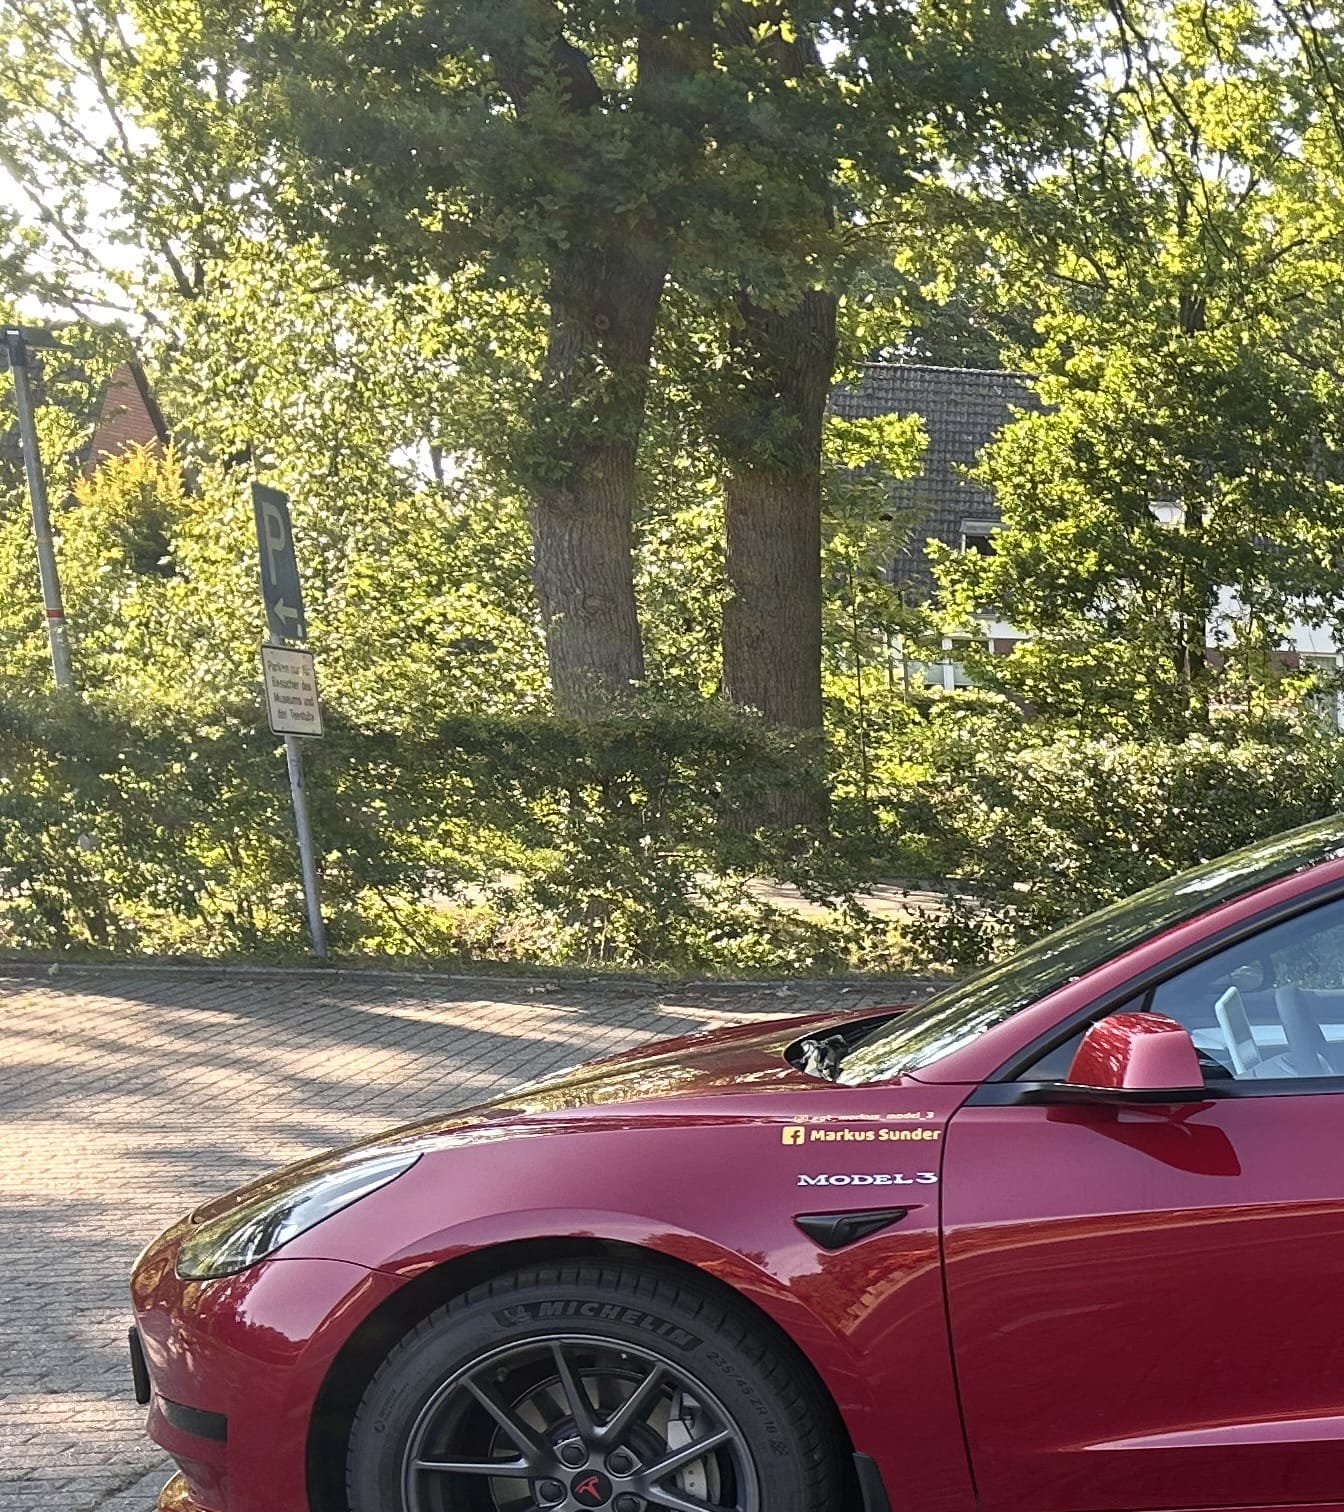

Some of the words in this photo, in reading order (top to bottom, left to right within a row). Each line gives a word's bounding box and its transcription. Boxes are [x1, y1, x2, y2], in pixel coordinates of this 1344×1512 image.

[262, 501, 286, 586] P
[810, 1128, 875, 1142] Markus
[878, 1127, 942, 1141] Sunder
[797, 1174, 914, 1187] MODEL
[915, 1172, 939, 1185] 3
[538, 1300, 695, 1347] MICHELIN
